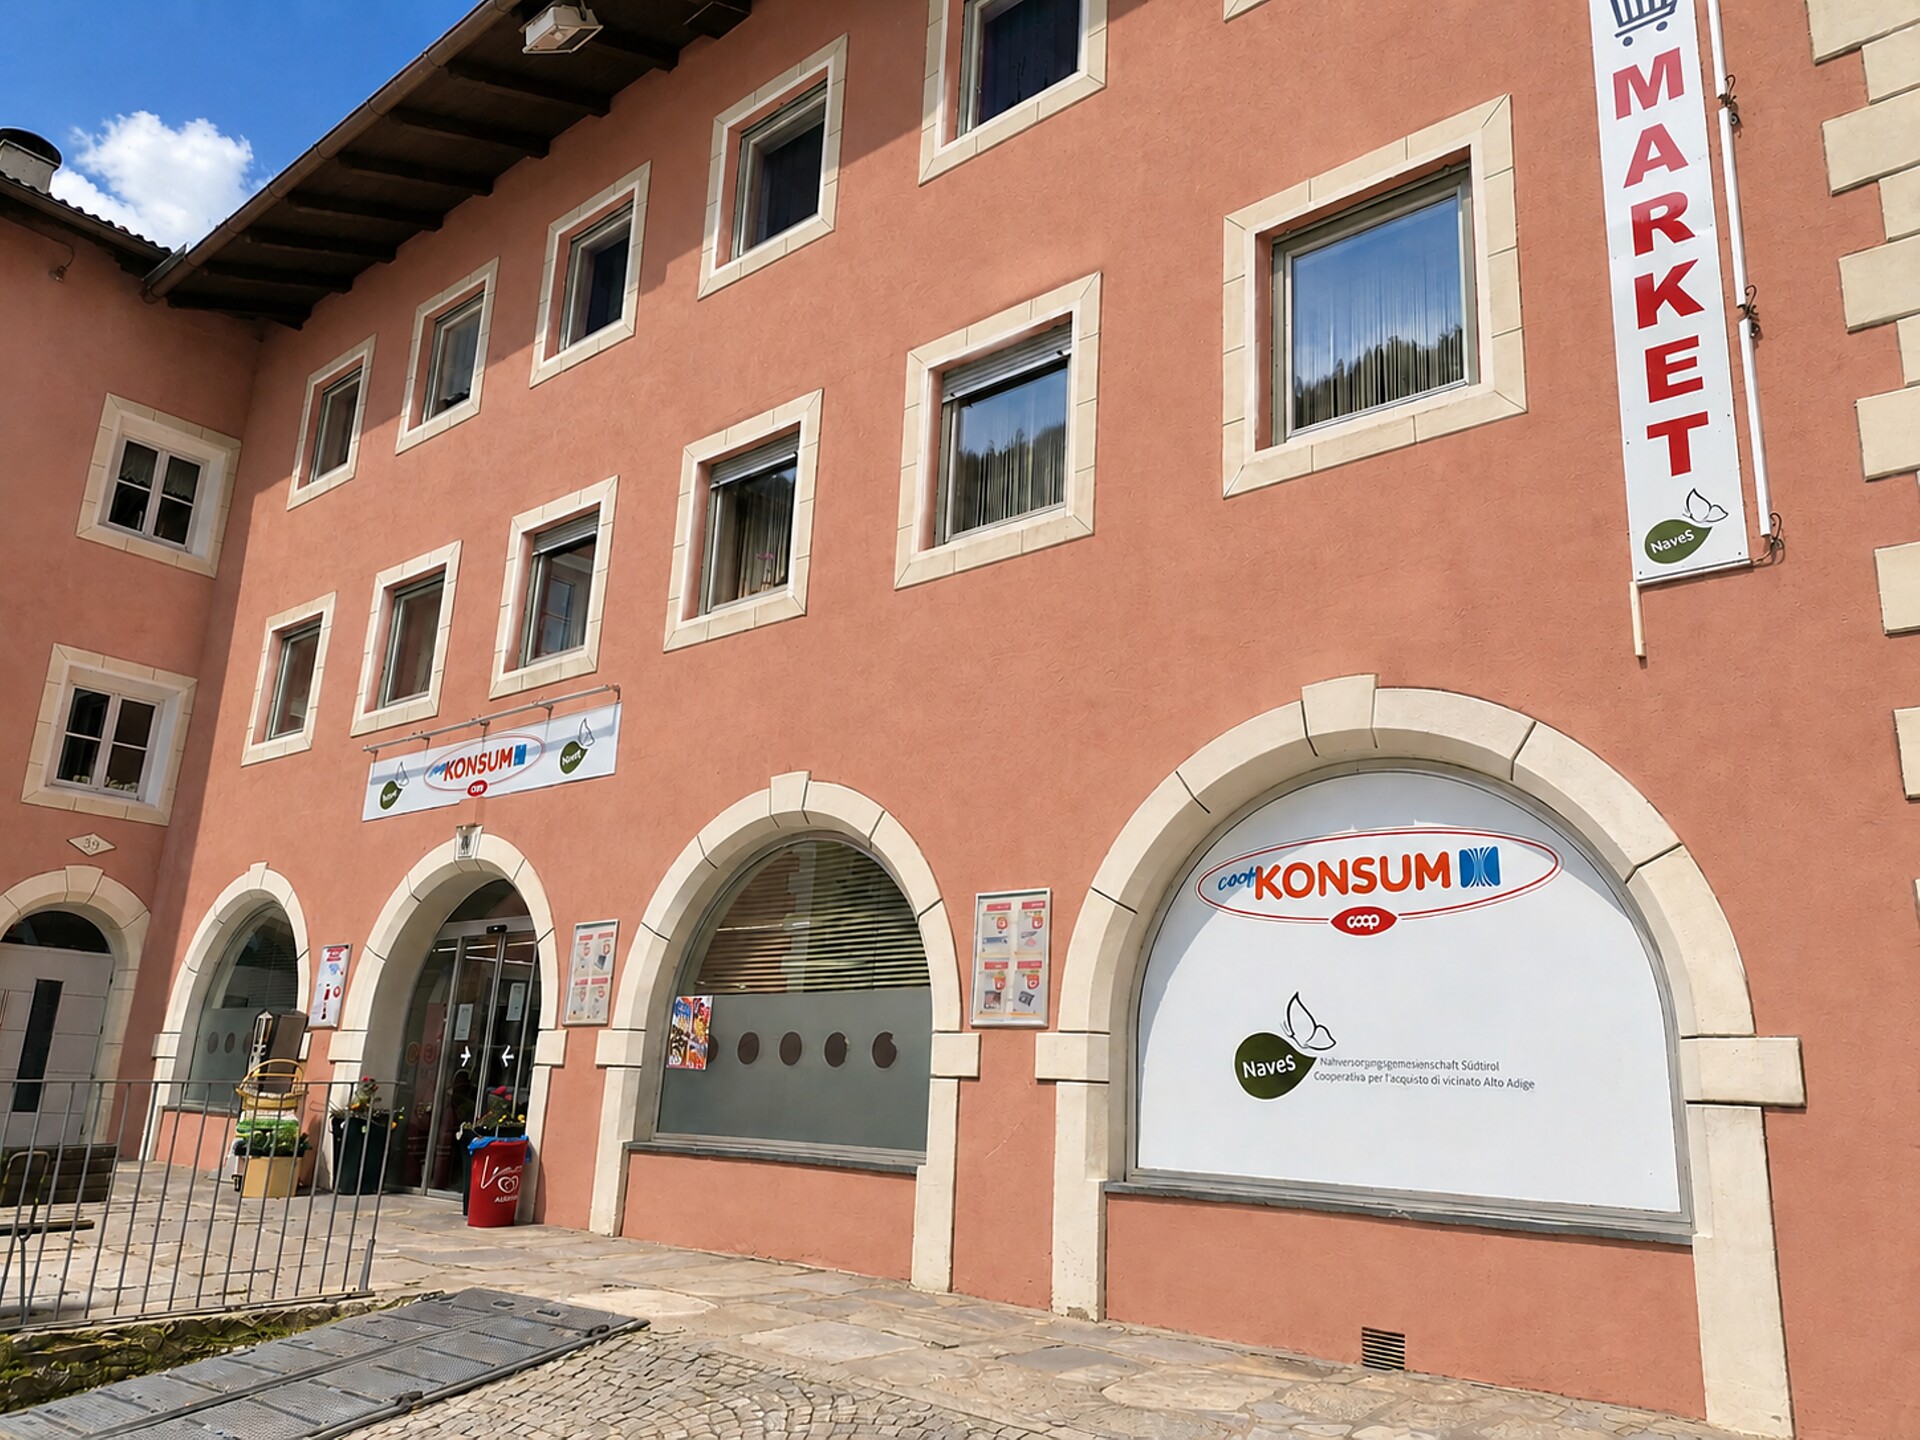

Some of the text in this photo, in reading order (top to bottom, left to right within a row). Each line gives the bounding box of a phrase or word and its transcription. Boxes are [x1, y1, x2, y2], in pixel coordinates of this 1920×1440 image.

[1612, 47, 1709, 477] MARKET
[443, 747, 514, 782] KONSUM
[1255, 851, 1452, 901] KONSUM
[1346, 913, 1380, 931] coop
[1461, 1060, 1500, 1072] Südtirol
[1313, 1071, 1366, 1083] Cooperativa
[1368, 1074, 1383, 1085] per
[1431, 1075, 1441, 1085] di
[1443, 1076, 1481, 1087] vicinato
[1483, 1077, 1504, 1088] Alto
[1506, 1078, 1536, 1091] Adige
